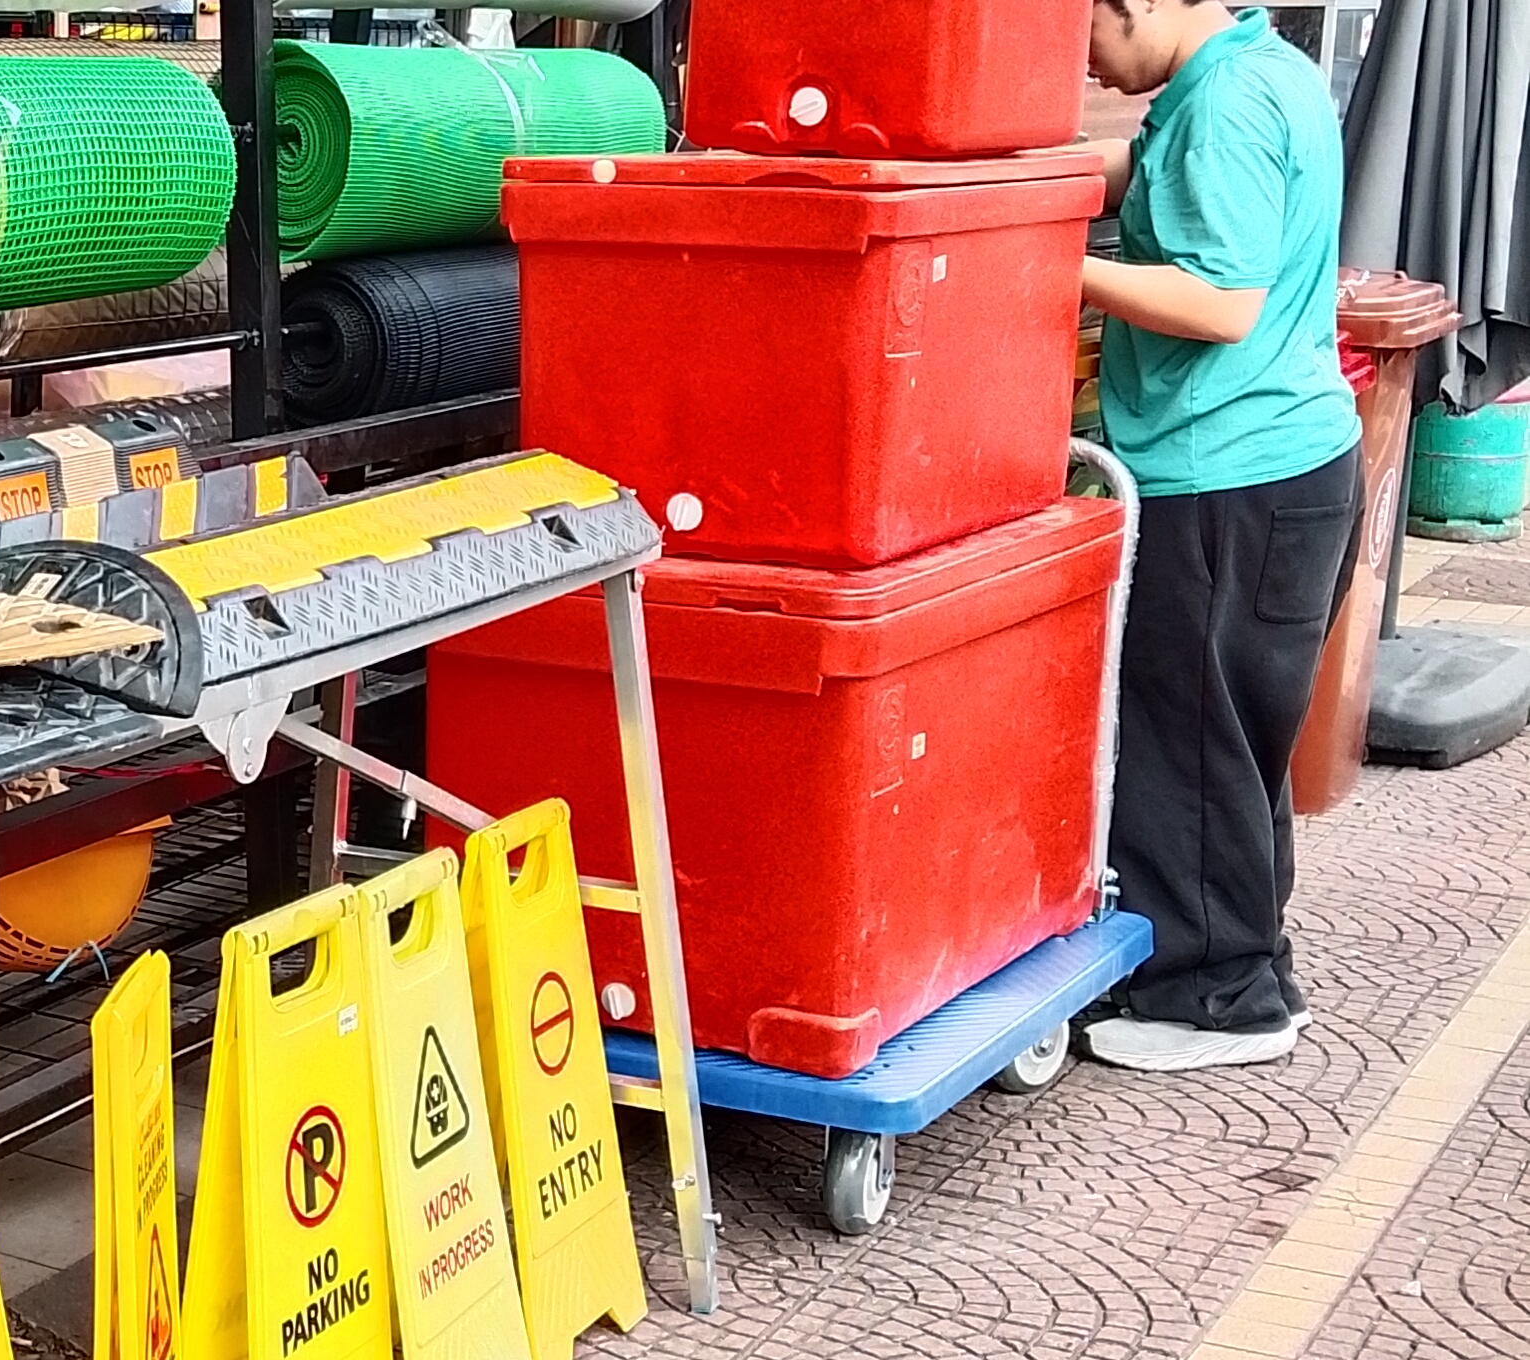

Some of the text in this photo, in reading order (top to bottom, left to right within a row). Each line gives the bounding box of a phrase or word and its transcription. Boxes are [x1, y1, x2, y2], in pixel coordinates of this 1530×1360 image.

[134, 461, 173, 488] STOP
[0, 485, 42, 520] STOP
[549, 1102, 577, 1152] NO
[423, 1172, 473, 1232] WORK
[538, 1139, 603, 1221] ENTRY
[307, 1247, 339, 1297] NO
[418, 1218, 495, 1301] IN PROGRESS
[282, 1268, 370, 1359] PARKING
